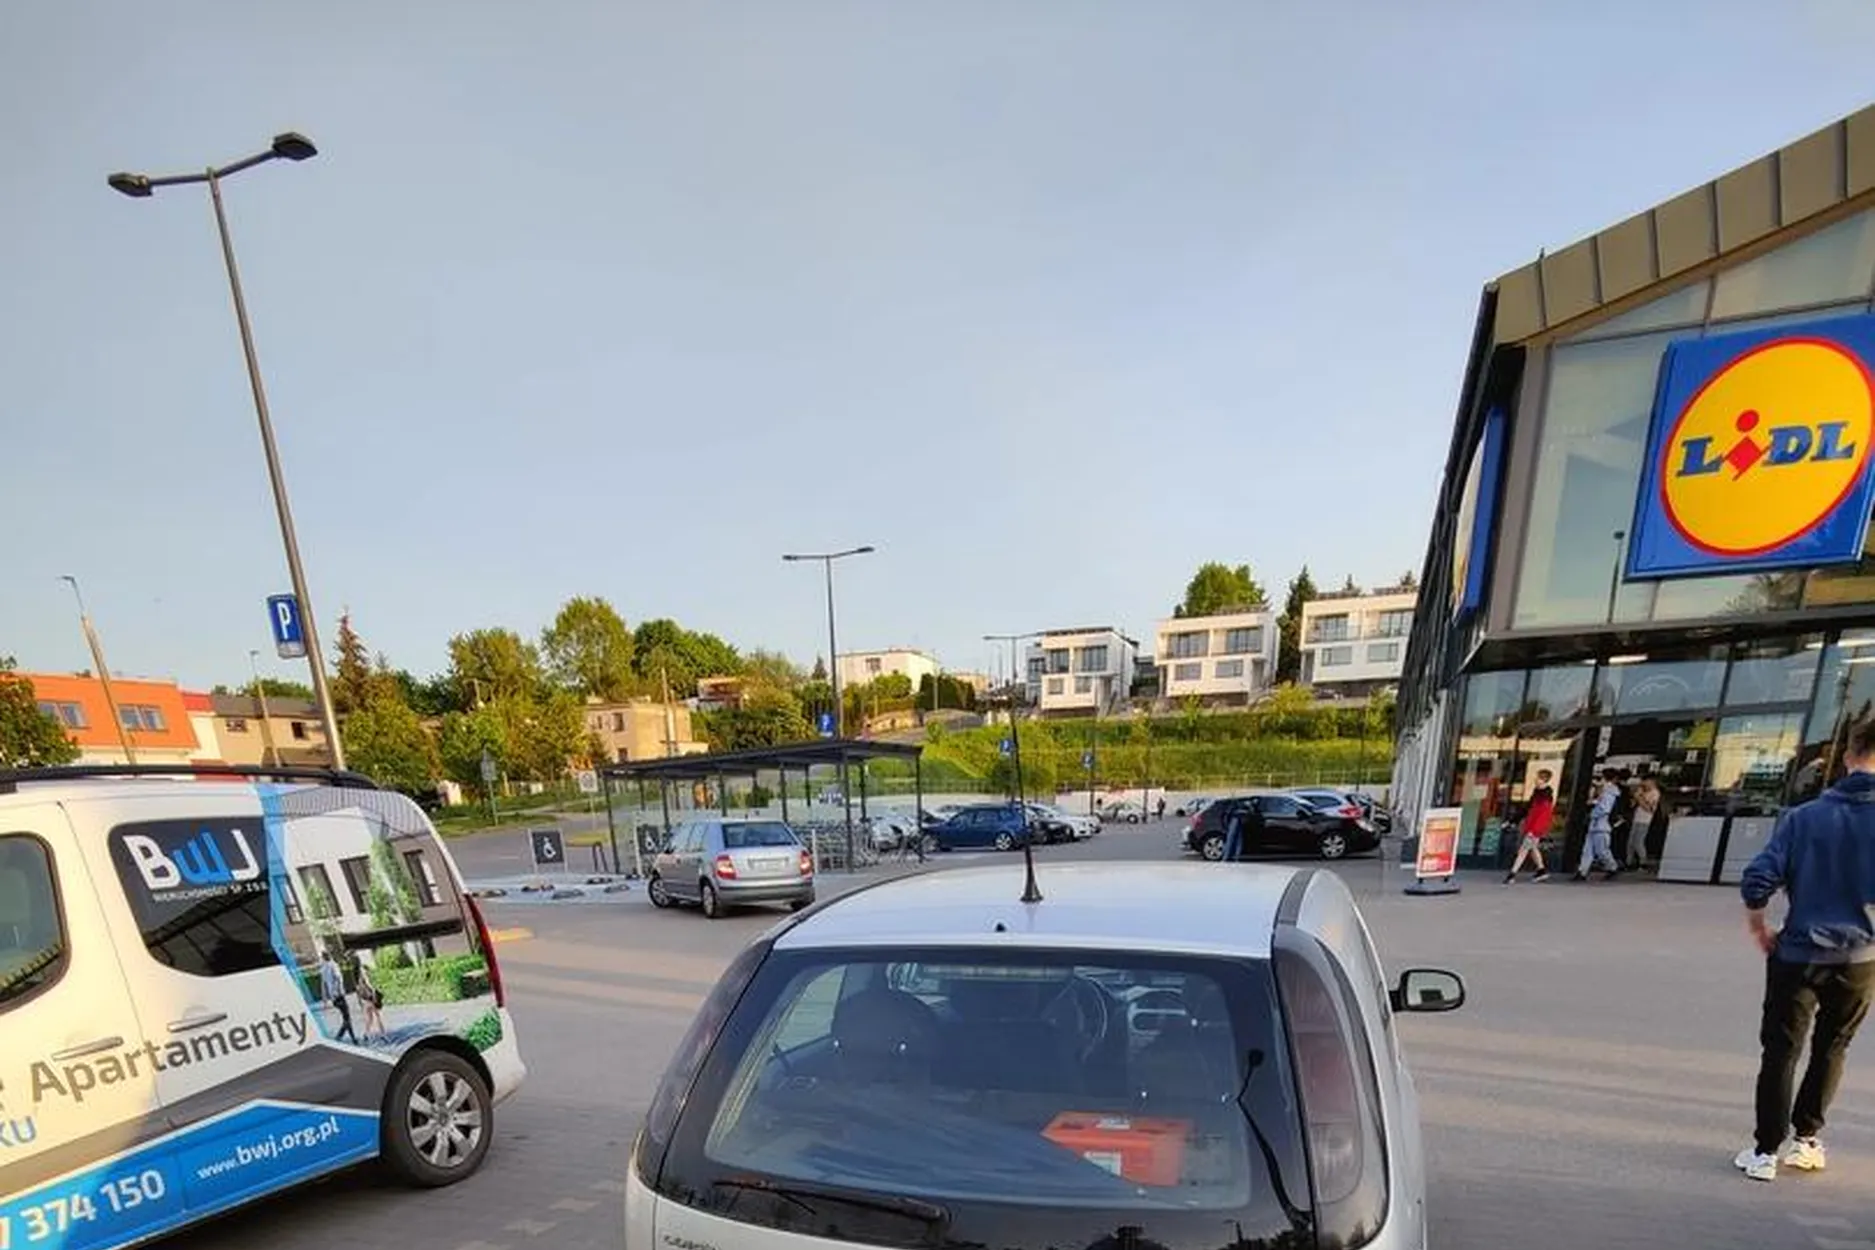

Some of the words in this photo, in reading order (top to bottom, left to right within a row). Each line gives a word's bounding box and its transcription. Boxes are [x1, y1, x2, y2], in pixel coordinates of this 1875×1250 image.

[277, 602, 291, 640] P
[29, 1012, 308, 1102] Apartamenty
[196, 1115, 340, 1179] www.bwj.org.pl
[19, 1194, 97, 1241] 374
[100, 1170, 166, 1212] 150
